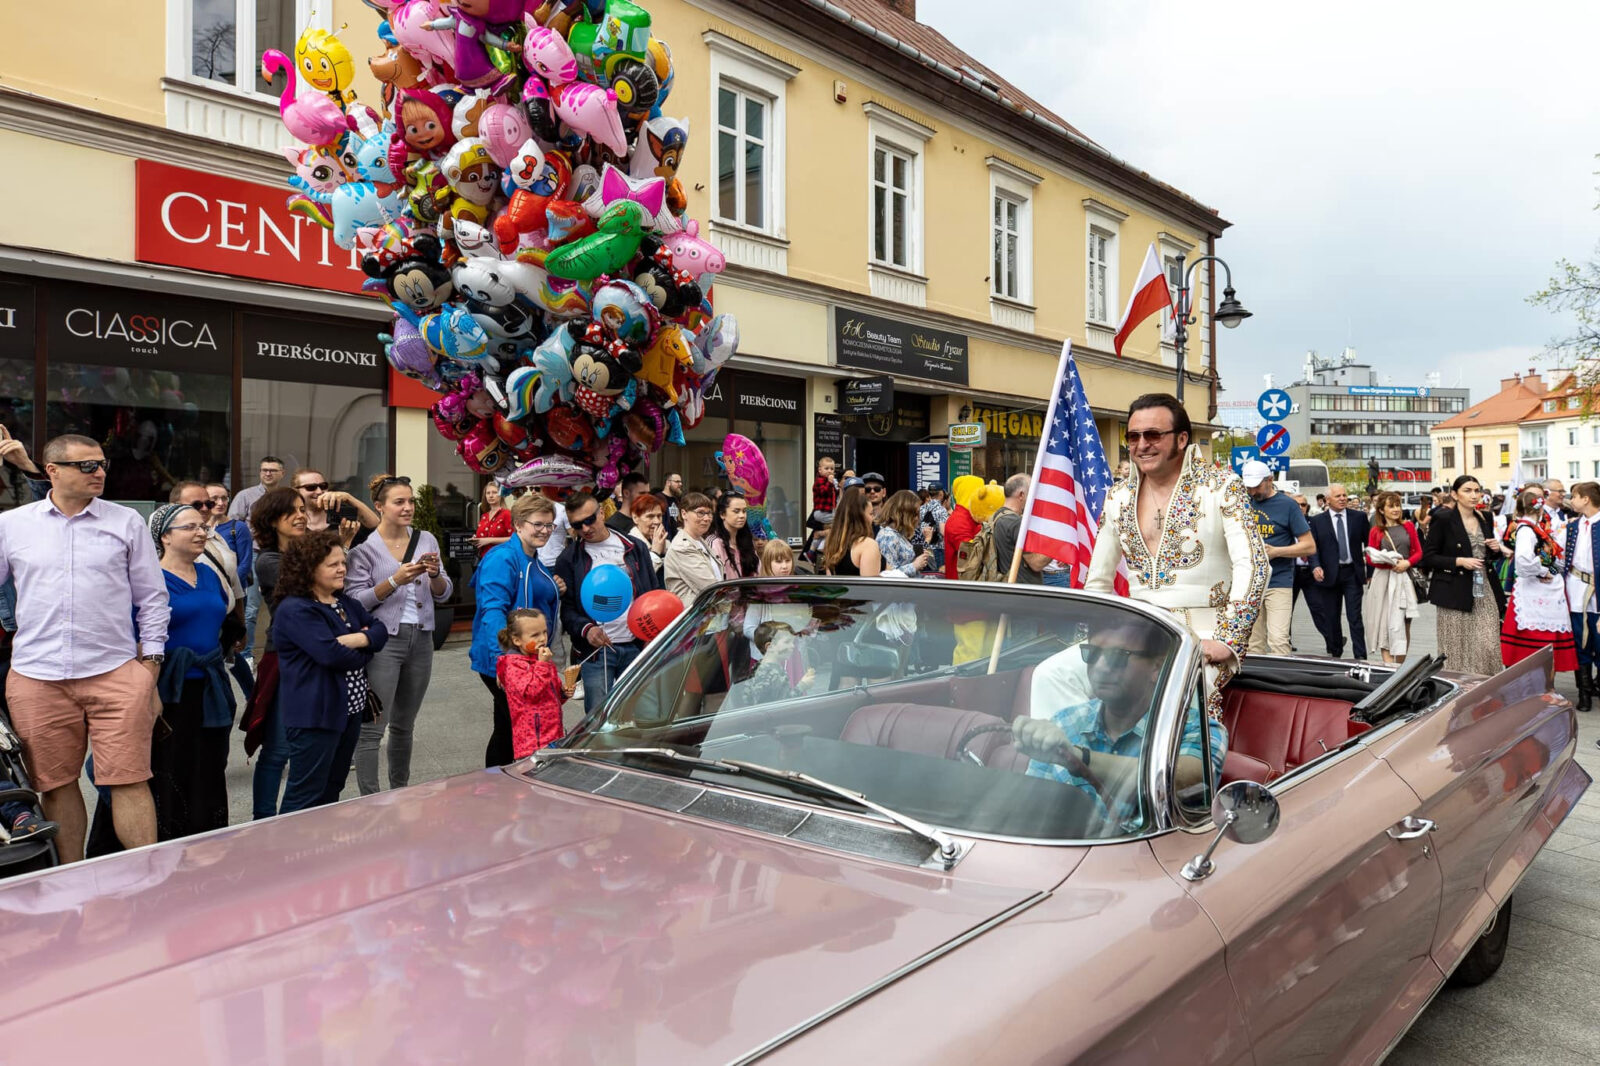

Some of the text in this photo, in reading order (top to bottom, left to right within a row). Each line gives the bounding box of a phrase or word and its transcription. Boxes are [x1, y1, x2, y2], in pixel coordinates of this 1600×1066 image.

[65, 308, 217, 350] CLASSICA
[866, 330, 887, 343] Beauty
[887, 334, 902, 345] Team
[131, 346, 158, 354] touch
[910, 333, 940, 352] Studio
[256, 341, 377, 367] PIERŚCIONKI
[740, 394, 797, 410] PIERŚCIONKI
[951, 426, 979, 436] SKLEP
[972, 408, 1043, 439] KSIĘGAR
